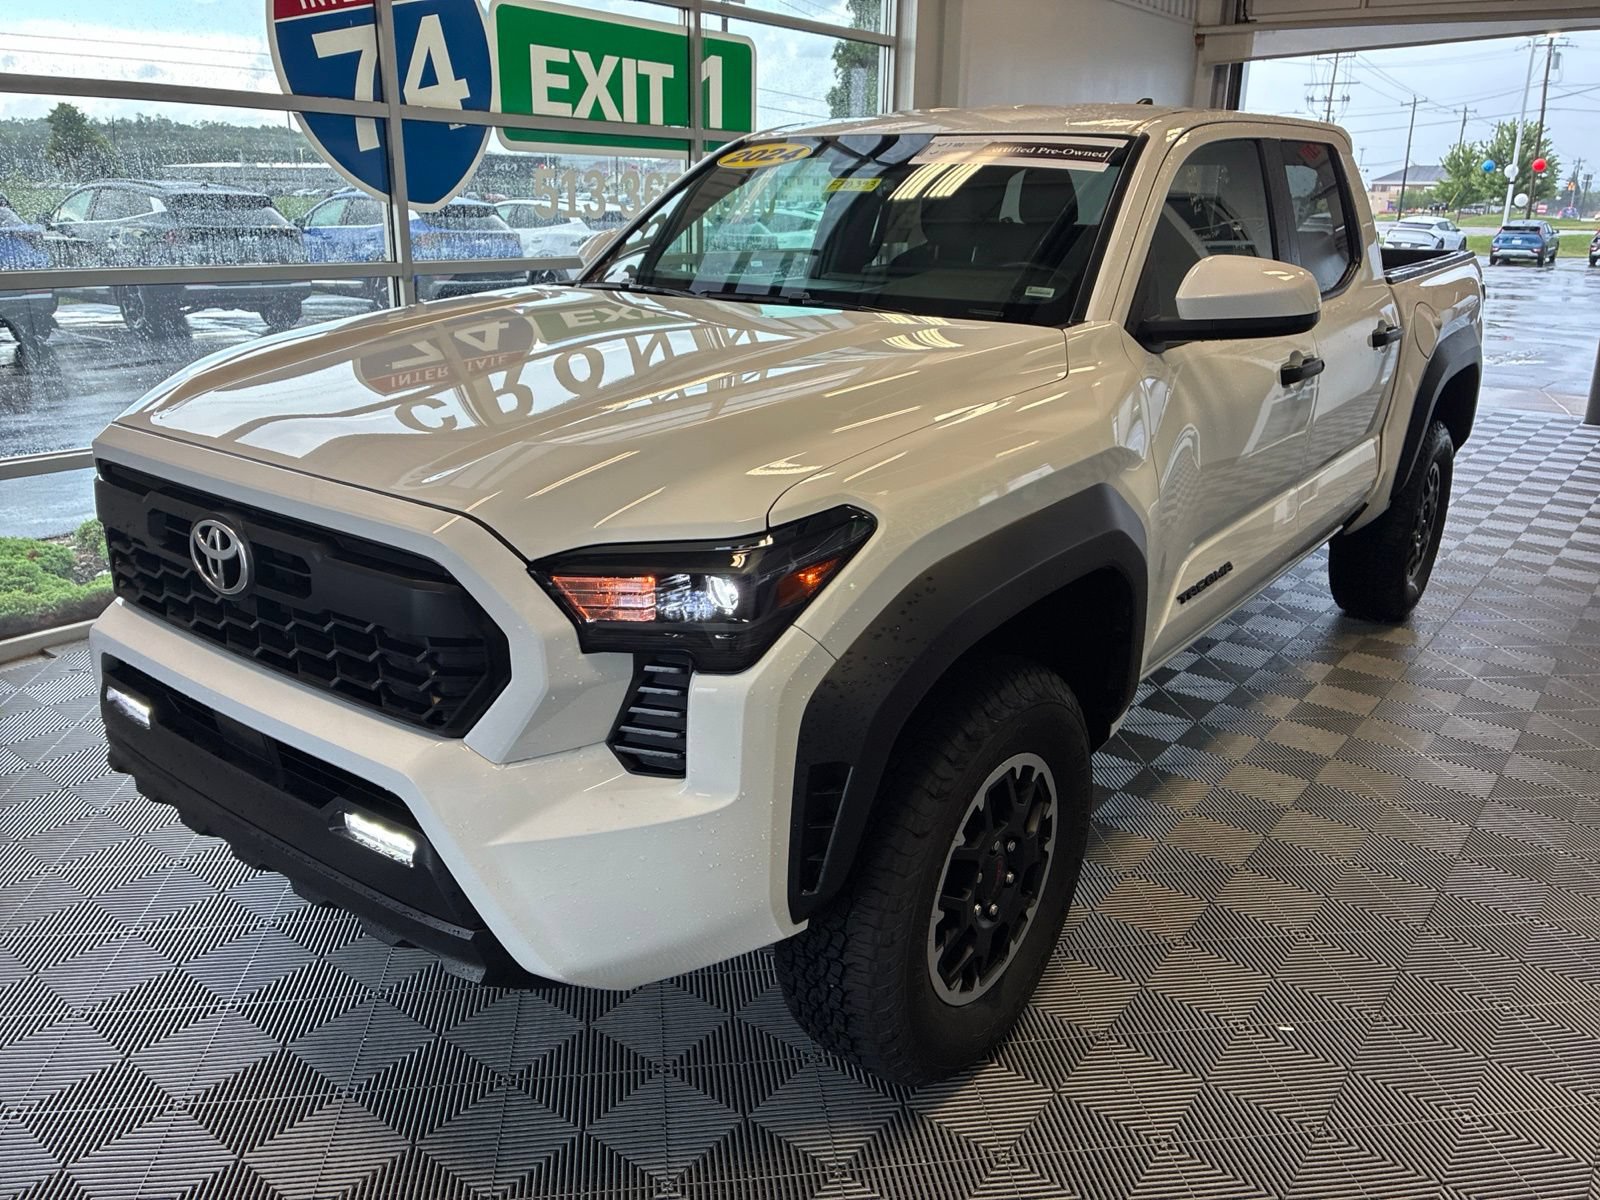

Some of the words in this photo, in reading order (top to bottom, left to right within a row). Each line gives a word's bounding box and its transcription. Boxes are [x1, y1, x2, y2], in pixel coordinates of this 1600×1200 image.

[311, 14, 470, 152] 74
[530, 44, 674, 127] EXIT
[701, 55, 724, 129] 1
[723, 146, 806, 163] 2024
[1037, 146, 1108, 159] Pre-Owned
[1176, 561, 1234, 605] TACOMA
